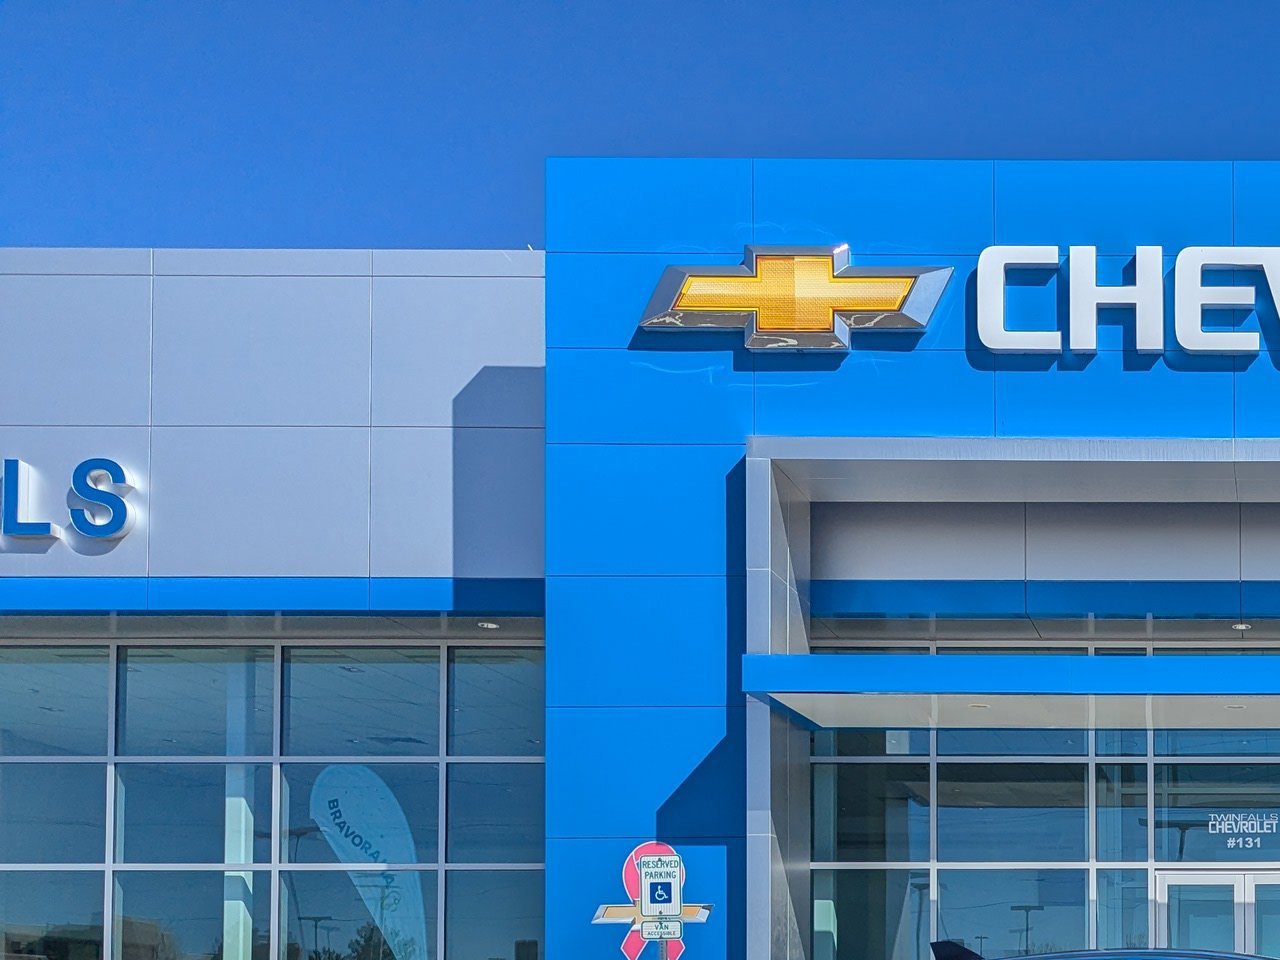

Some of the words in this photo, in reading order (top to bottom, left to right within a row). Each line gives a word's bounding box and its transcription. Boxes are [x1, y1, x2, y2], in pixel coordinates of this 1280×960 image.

[1208, 821, 1279, 834] CHEVROLET
[327, 798, 395, 889] BRAVORAA
[1227, 837, 1261, 848] #131
[642, 860, 679, 869] RESERVED
[644, 871, 677, 879] PARKING
